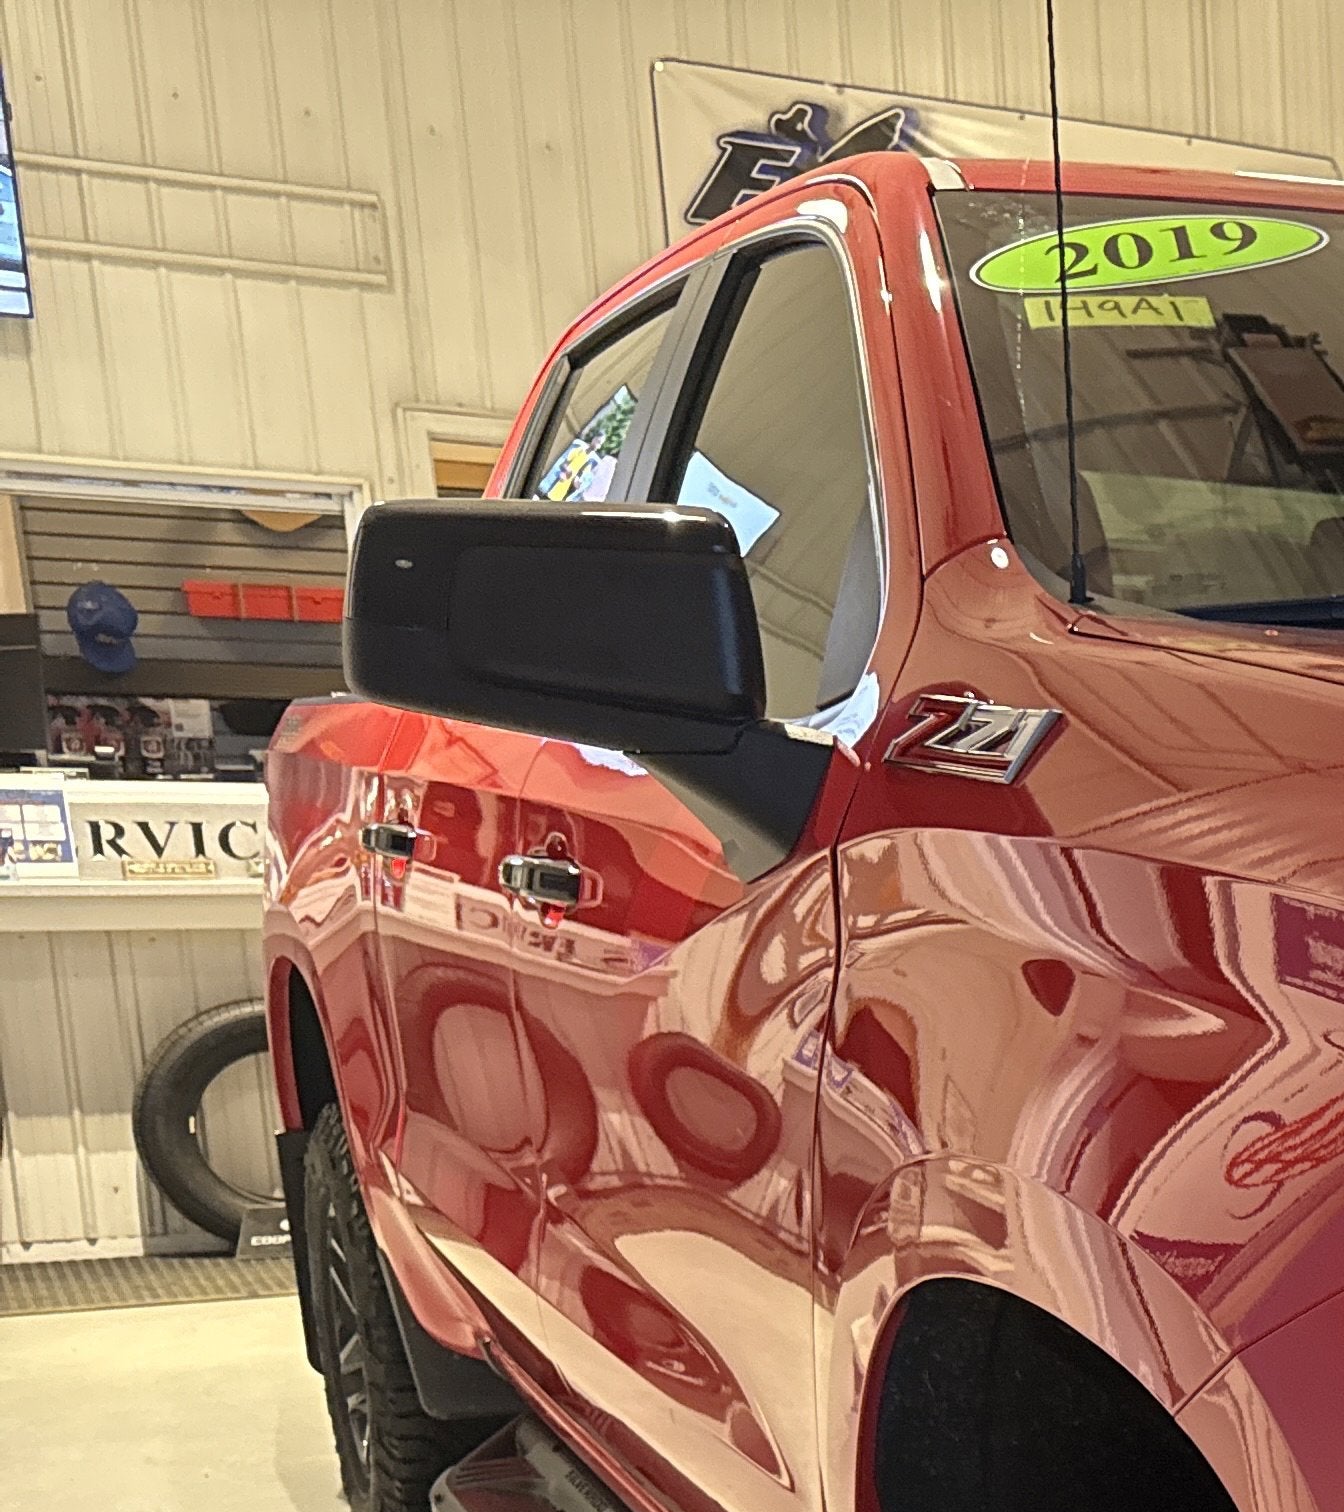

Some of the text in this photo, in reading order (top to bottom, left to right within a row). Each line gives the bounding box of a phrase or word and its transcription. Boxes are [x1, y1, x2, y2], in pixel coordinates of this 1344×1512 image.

[1045, 221, 1257, 283] 2019
[87, 820, 261, 861] RVIC
[250, 1234, 291, 1246] COOP
